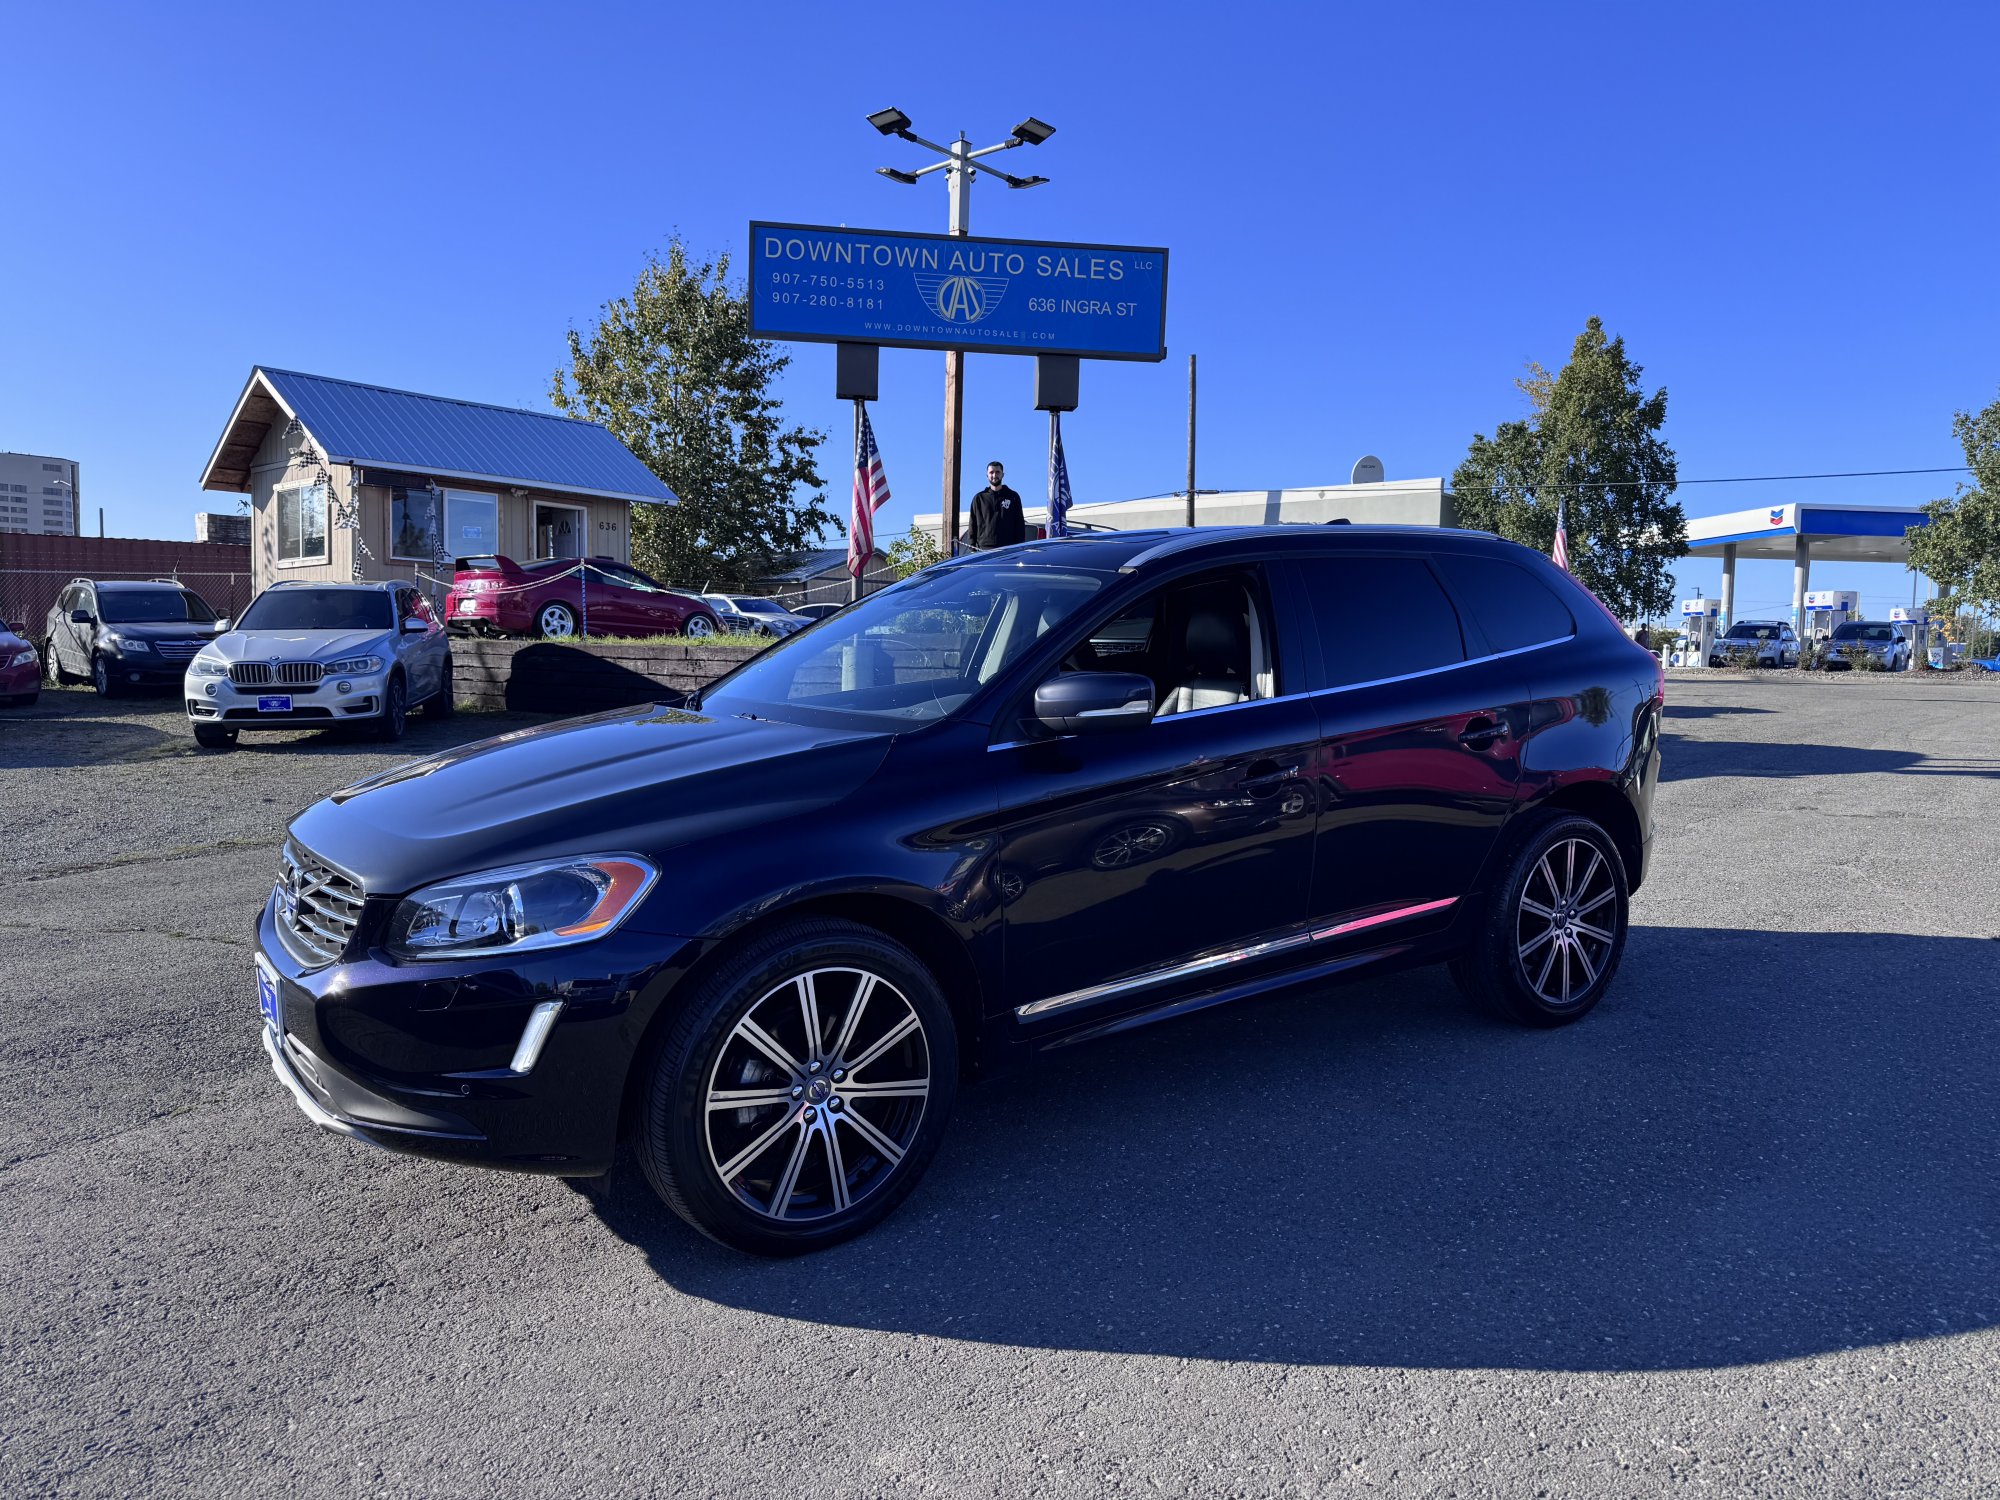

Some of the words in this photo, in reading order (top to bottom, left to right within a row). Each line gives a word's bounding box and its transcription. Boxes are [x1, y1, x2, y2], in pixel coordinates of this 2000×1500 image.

[765, 237, 938, 270] DOWNTOWN
[949, 250, 1024, 275] AUTO
[1036, 255, 1124, 281] SALES
[1134, 261, 1153, 270] LLC
[772, 272, 884, 291] 907-750-5513
[772, 292, 883, 310] 907-280-8181
[1028, 298, 1056, 312] 636
[1061, 299, 1111, 315] INGRA
[1116, 302, 1138, 317] ST
[864, 322, 1055, 340] WWW.DOWNTOWNAUTOSALE.COM
[599, 521, 617, 531] 636
